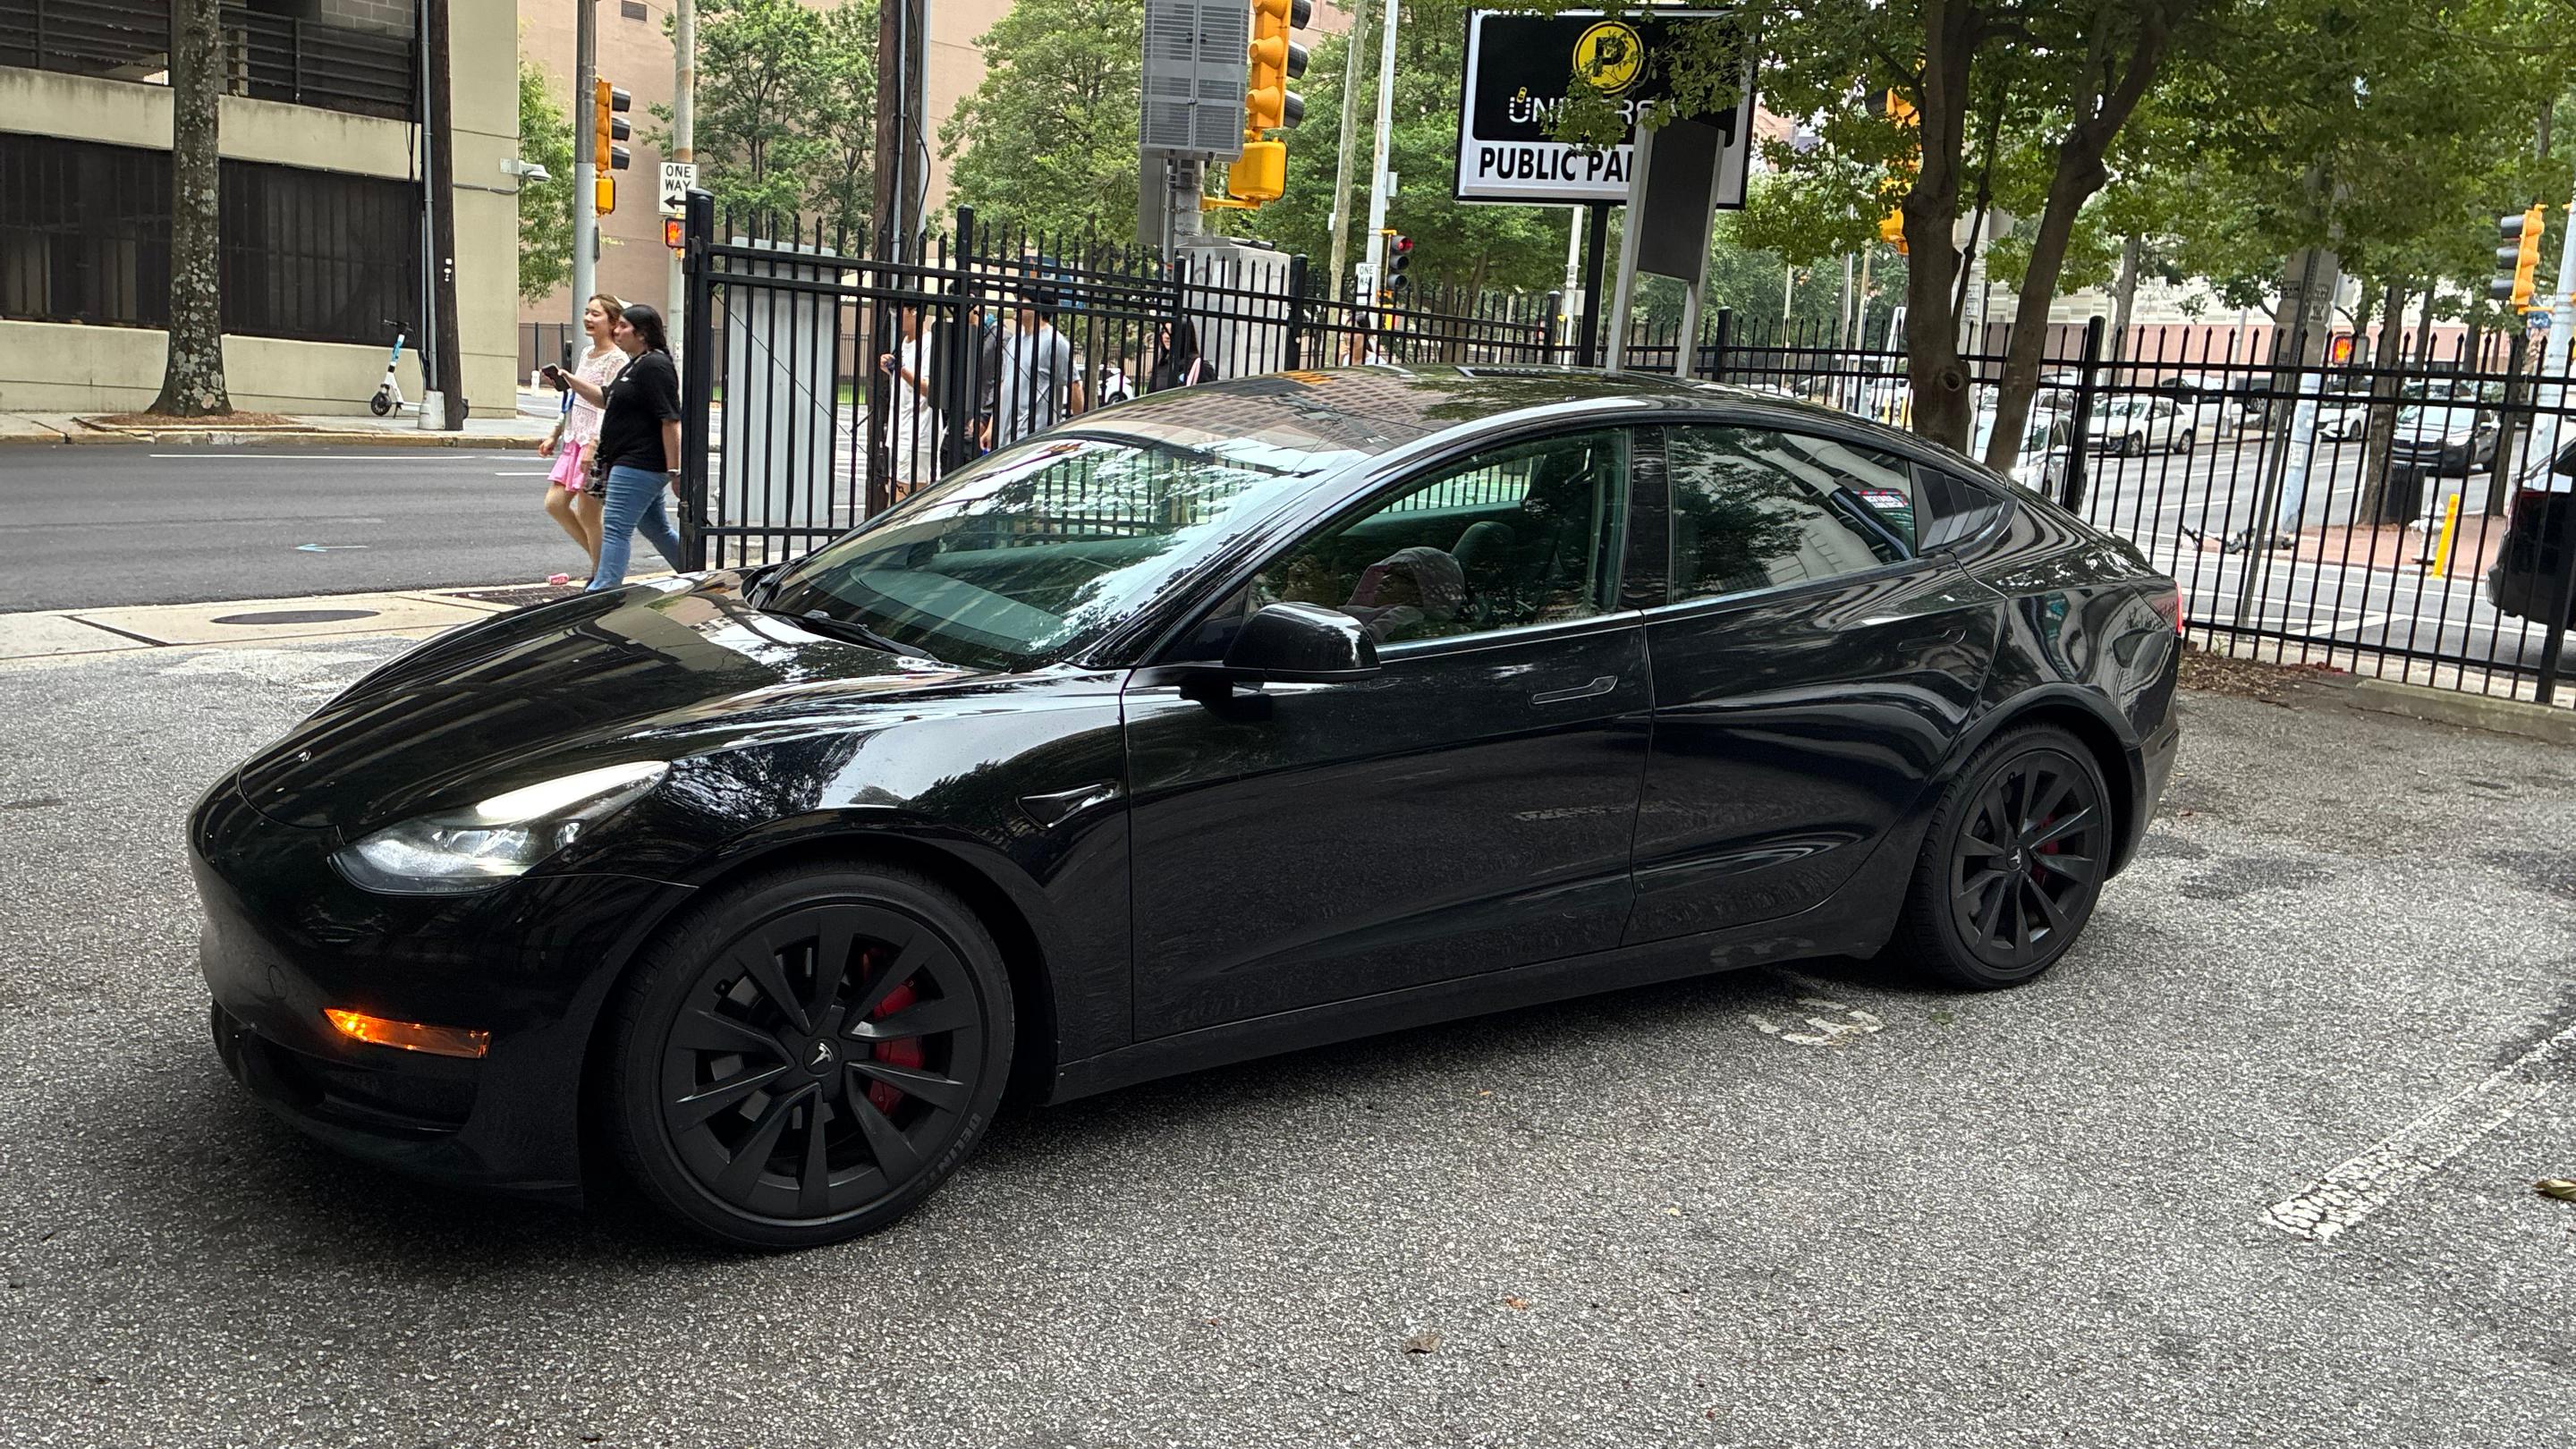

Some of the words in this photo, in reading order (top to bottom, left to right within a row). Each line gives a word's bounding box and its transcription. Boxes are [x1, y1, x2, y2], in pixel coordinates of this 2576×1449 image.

[1593, 37, 1626, 77] P
[1479, 147, 1578, 182] PUBLIC
[665, 165, 691, 178] ONE
[665, 179, 691, 192] WAY
[1359, 265, 1375, 275] ONE
[1359, 276, 1372, 286] WA
